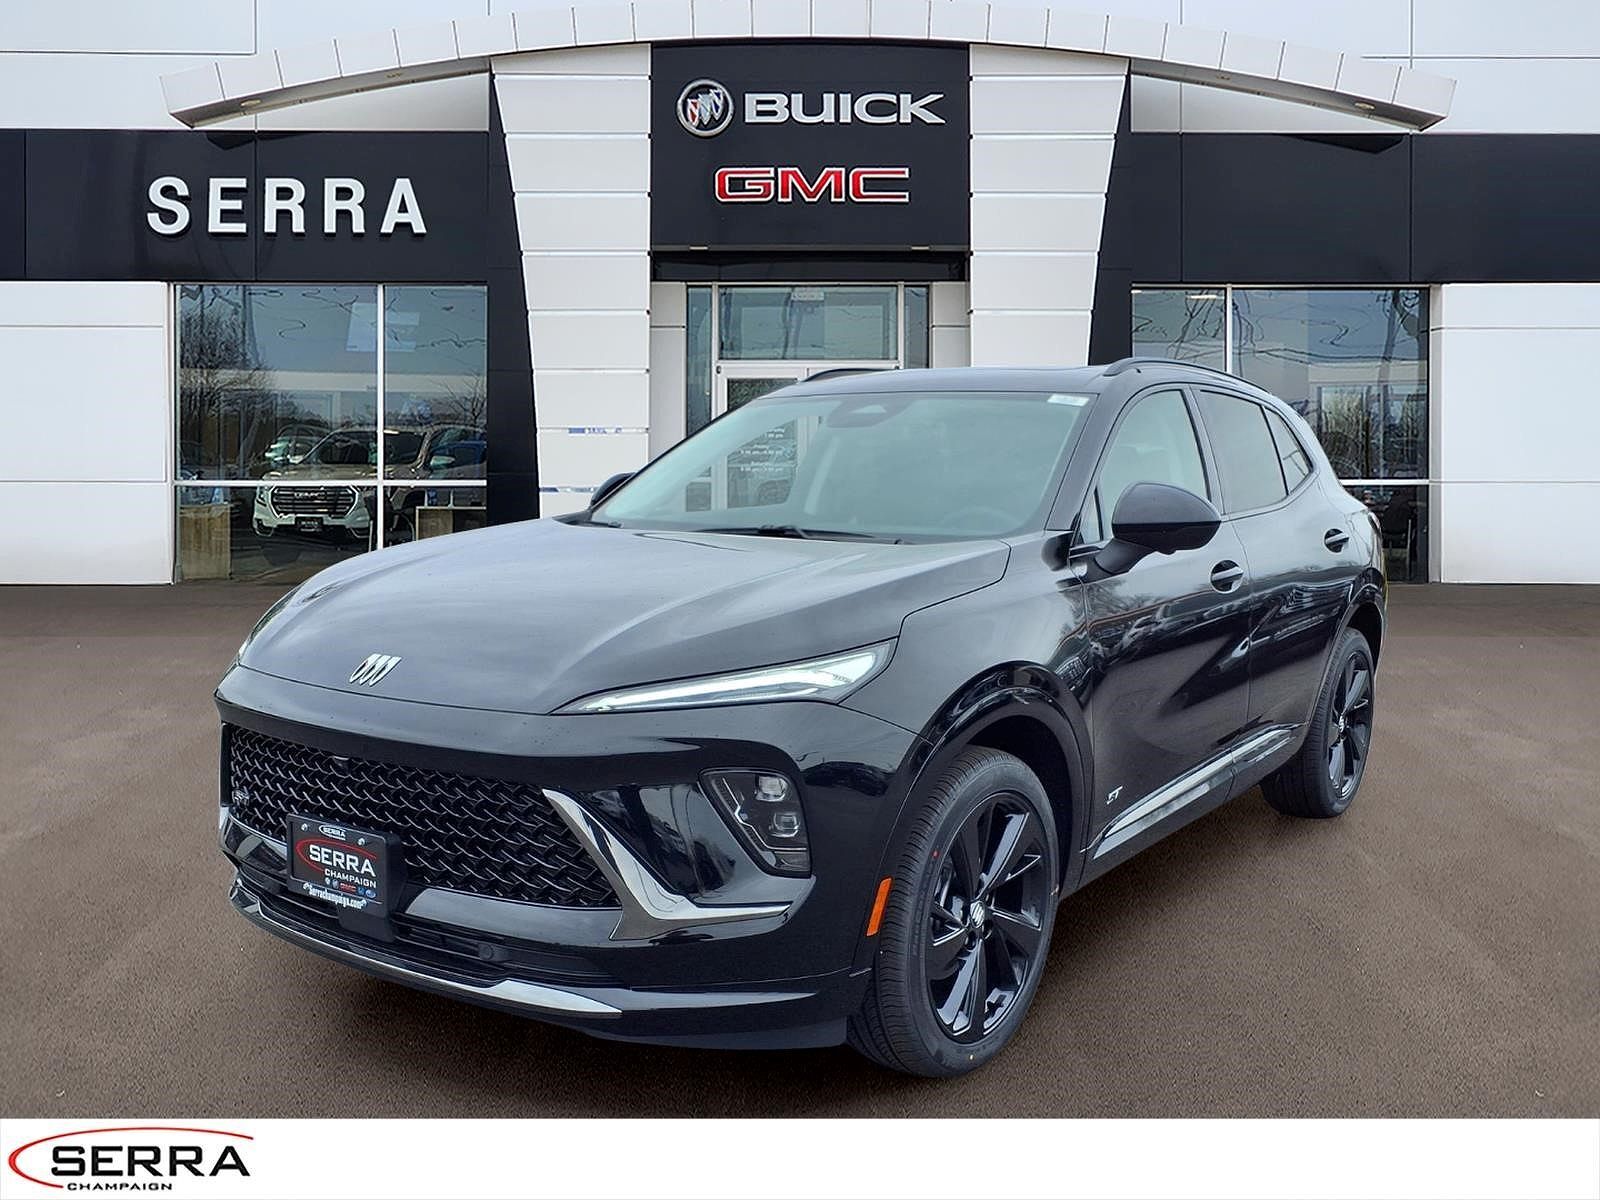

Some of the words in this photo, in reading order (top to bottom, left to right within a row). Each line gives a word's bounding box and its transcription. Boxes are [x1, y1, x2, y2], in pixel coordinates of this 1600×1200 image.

[744, 92, 946, 124] BUICK
[714, 166, 910, 203] GMC
[147, 175, 428, 235] SERRA
[309, 844, 376, 877] SERRA
[324, 868, 377, 889] CHAMPAIGN
